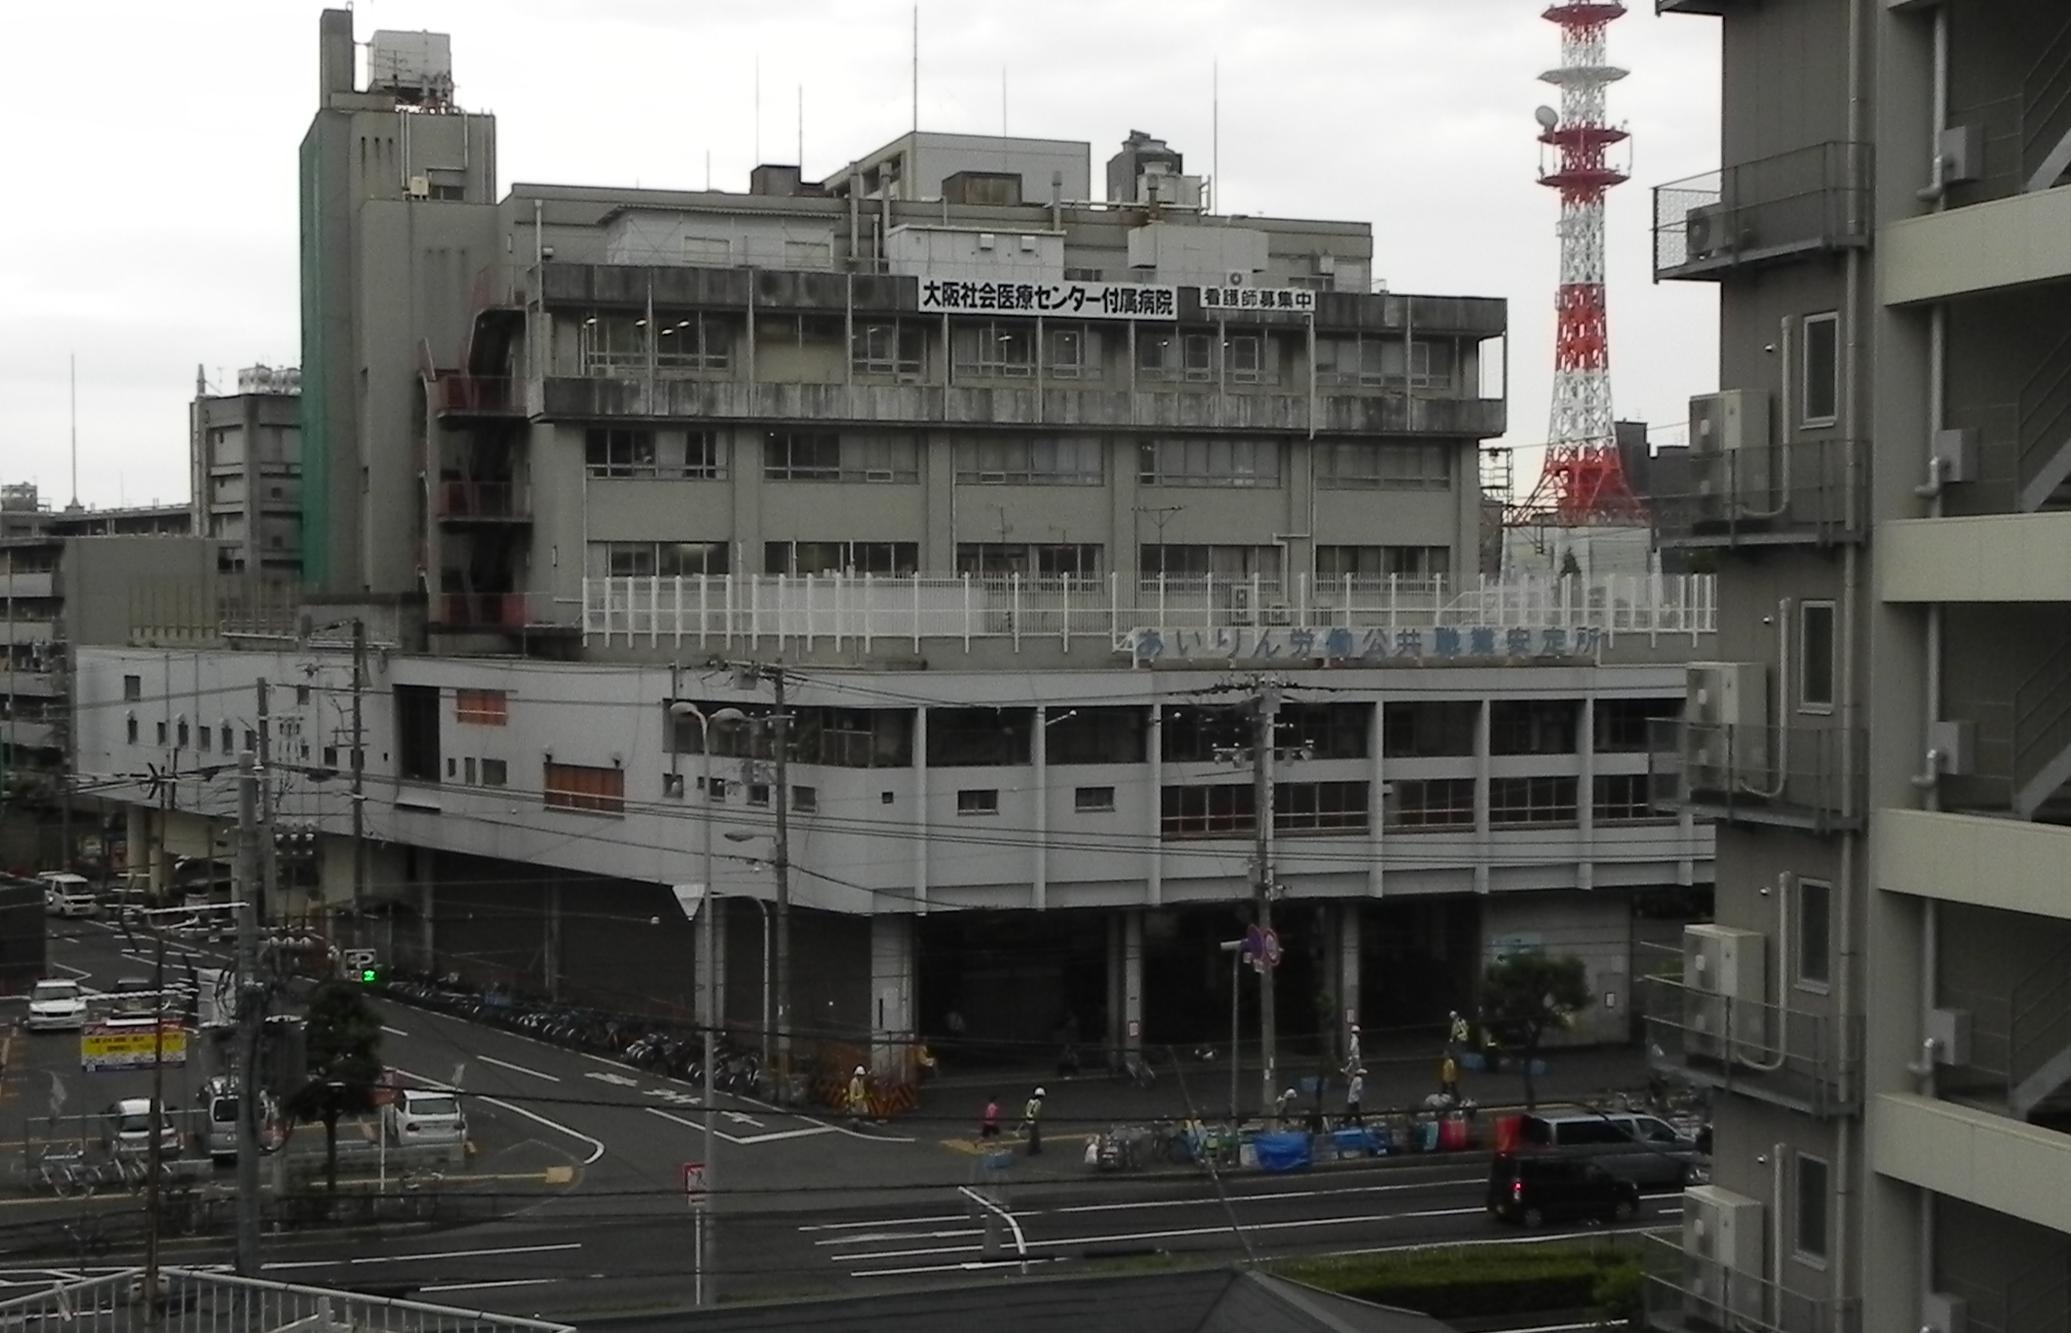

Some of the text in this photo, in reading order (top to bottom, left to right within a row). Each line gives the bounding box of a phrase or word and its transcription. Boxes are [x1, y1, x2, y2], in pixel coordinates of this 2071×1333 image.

[923, 280, 1173, 315] 大阪社会医療センター付属病院
[1205, 288, 1312, 309] 看護師募集中
